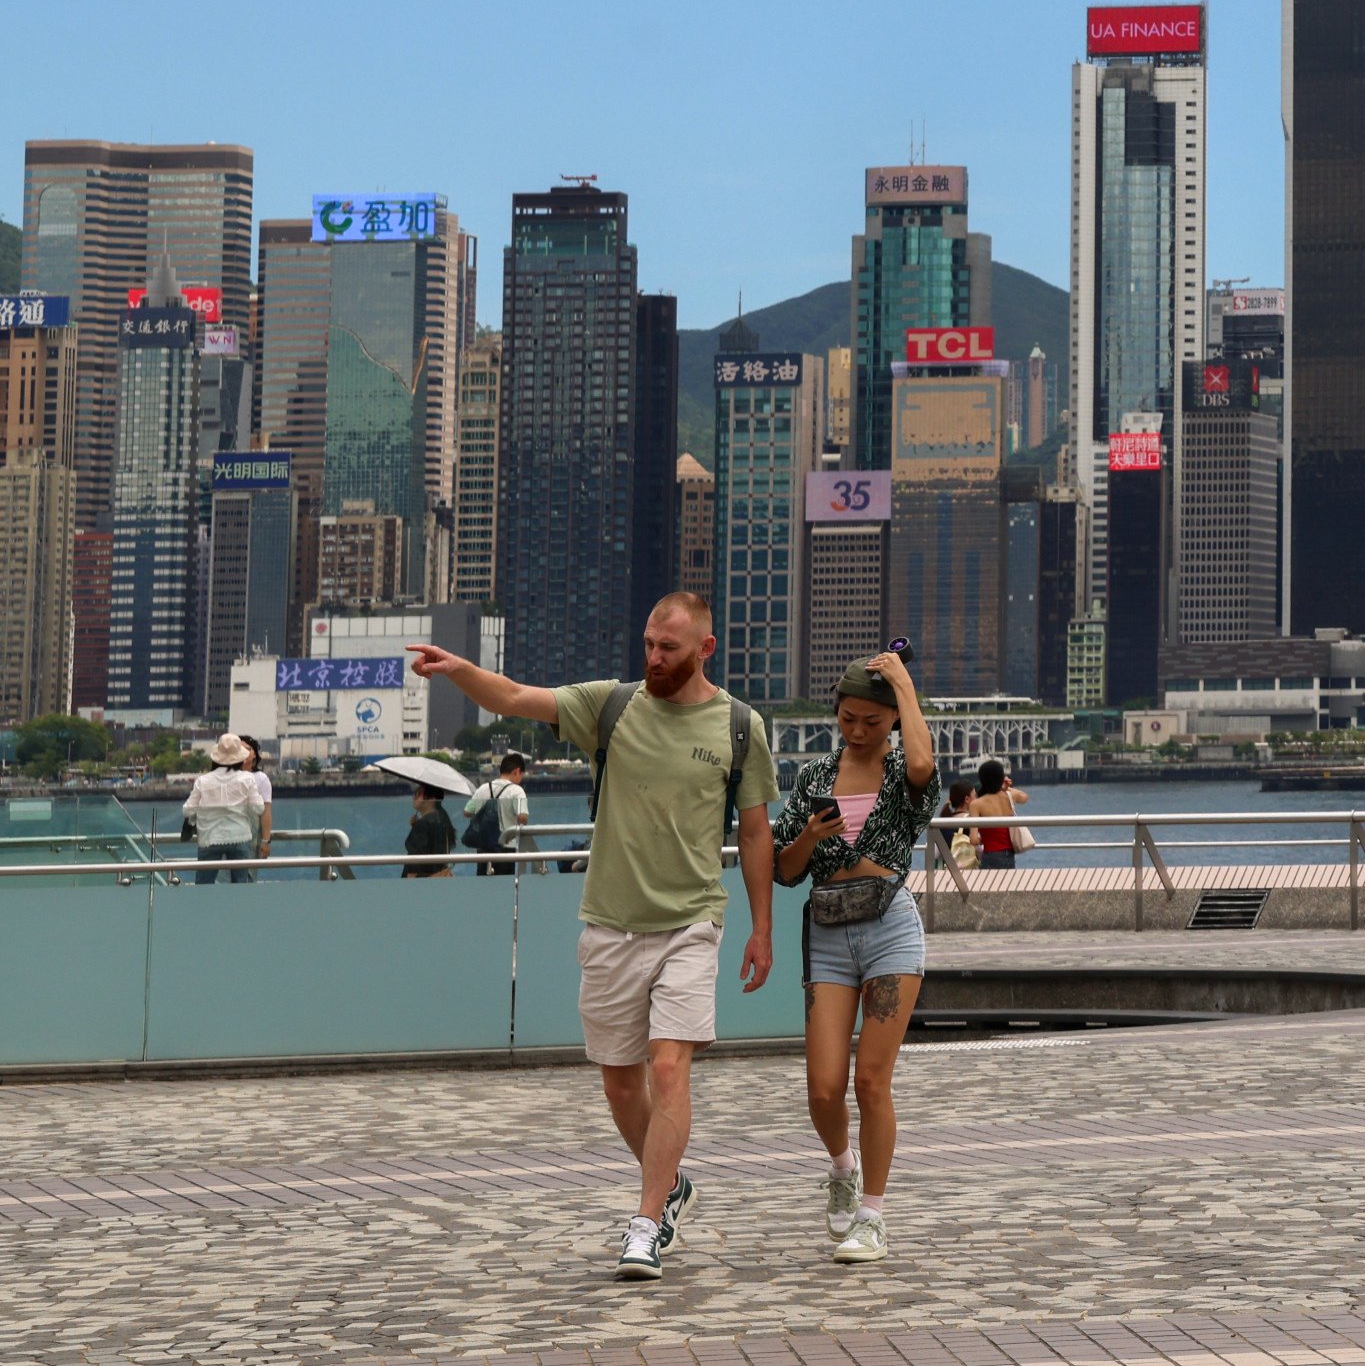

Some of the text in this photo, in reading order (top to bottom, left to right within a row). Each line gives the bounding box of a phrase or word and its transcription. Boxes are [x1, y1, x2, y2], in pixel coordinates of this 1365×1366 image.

[1091, 21, 1196, 39] UA FINANCE
[874, 174, 950, 193] 永明金融
[360, 201, 429, 233] 盈加
[908, 331, 993, 359] TCL
[1202, 394, 1230, 406] DBS
[214, 461, 289, 480] 光明国际
[830, 480, 871, 512] 35
[278, 660, 402, 689] 北京控股
[357, 725, 379, 733] SPCA
[691, 746, 721, 766] Nike
